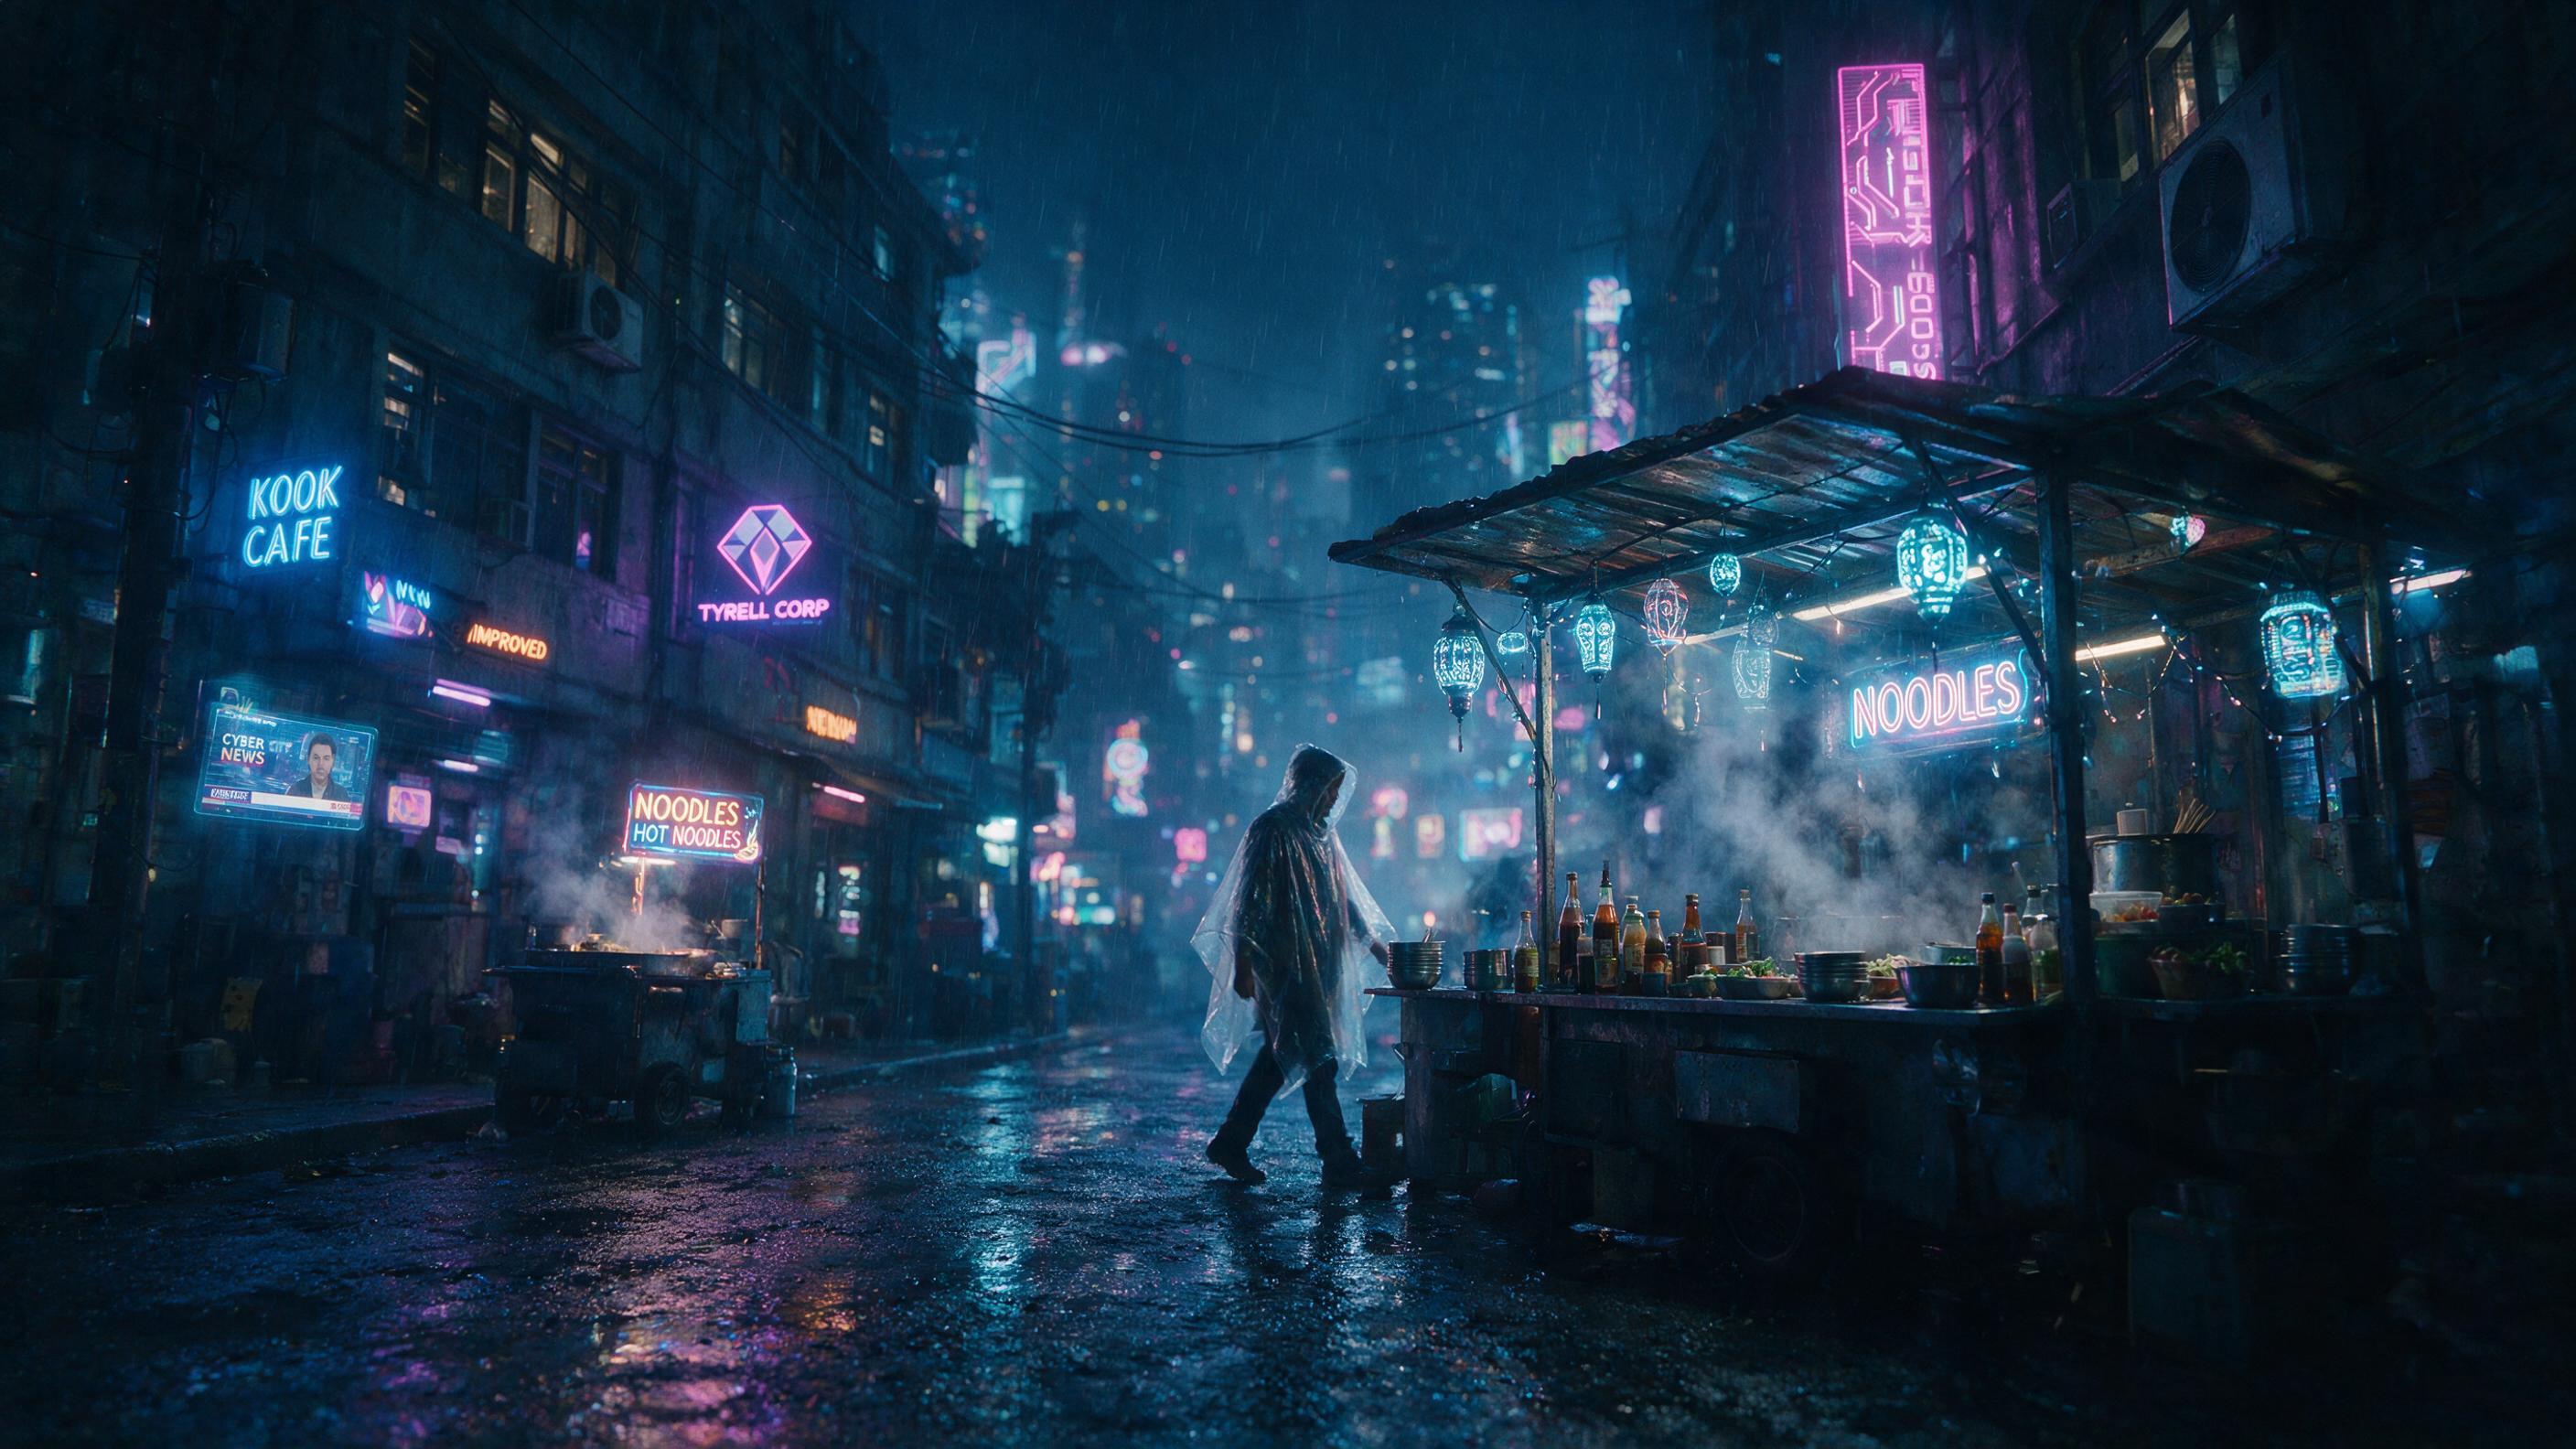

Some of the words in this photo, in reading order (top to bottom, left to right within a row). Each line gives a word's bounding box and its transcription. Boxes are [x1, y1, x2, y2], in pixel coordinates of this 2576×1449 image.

[248, 464, 343, 520] KOOK
[242, 516, 332, 567] CAFE
[698, 601, 770, 622] TYRELL
[774, 597, 830, 618] CORP
[1853, 660, 2021, 739] NOODLES
[220, 746, 265, 765] NEWS
[222, 733, 264, 750] CYBER
[635, 792, 739, 826] NOODLES
[633, 823, 669, 843] HOT
[672, 825, 741, 849] NOODLES
